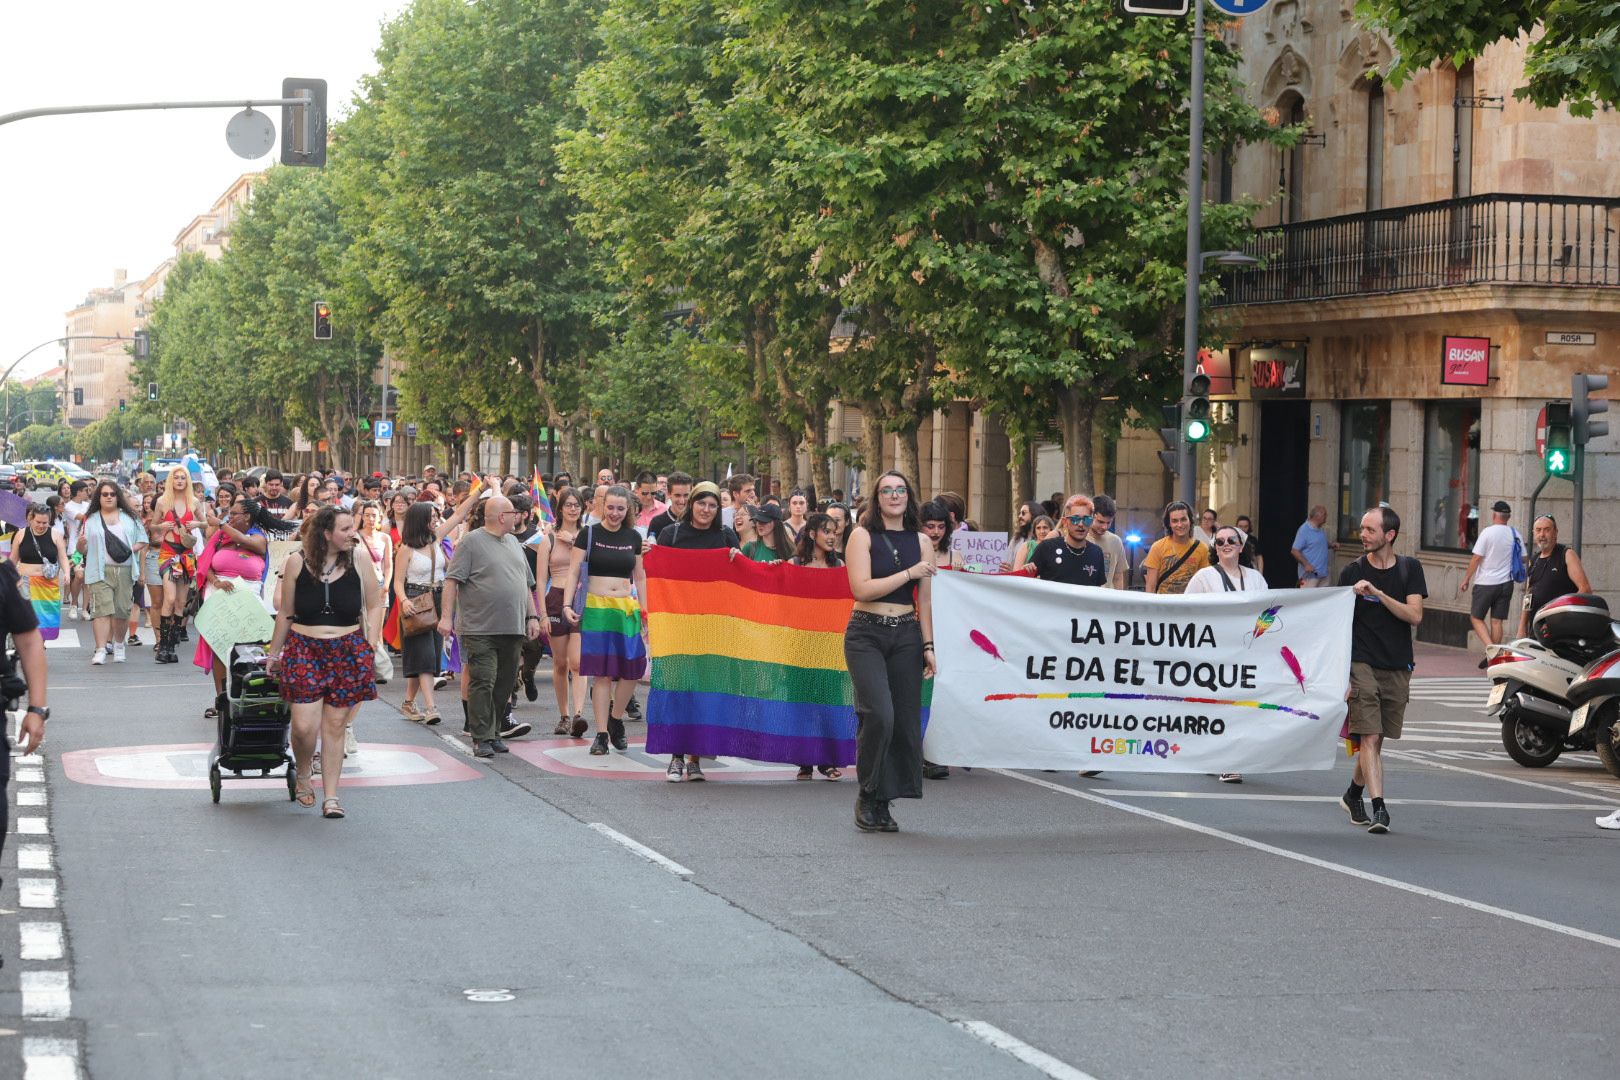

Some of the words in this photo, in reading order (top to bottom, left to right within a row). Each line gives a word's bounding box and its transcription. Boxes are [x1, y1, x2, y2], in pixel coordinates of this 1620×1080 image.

[1560, 334, 1582, 343] ROSA
[1448, 348, 1484, 363] BUSAN
[1251, 359, 1286, 389] BUSAN
[1070, 618, 1105, 645] LA
[1114, 619, 1217, 649] PLUMA
[1026, 655, 1058, 681] LE
[1065, 656, 1105, 682] DA
[1113, 658, 1145, 686] EL
[1153, 660, 1257, 692] TOQUE
[1049, 710, 1139, 732] ORGULLO
[1142, 713, 1226, 736] CHARRO
[1091, 737, 1181, 759] LGBTIAQ+
